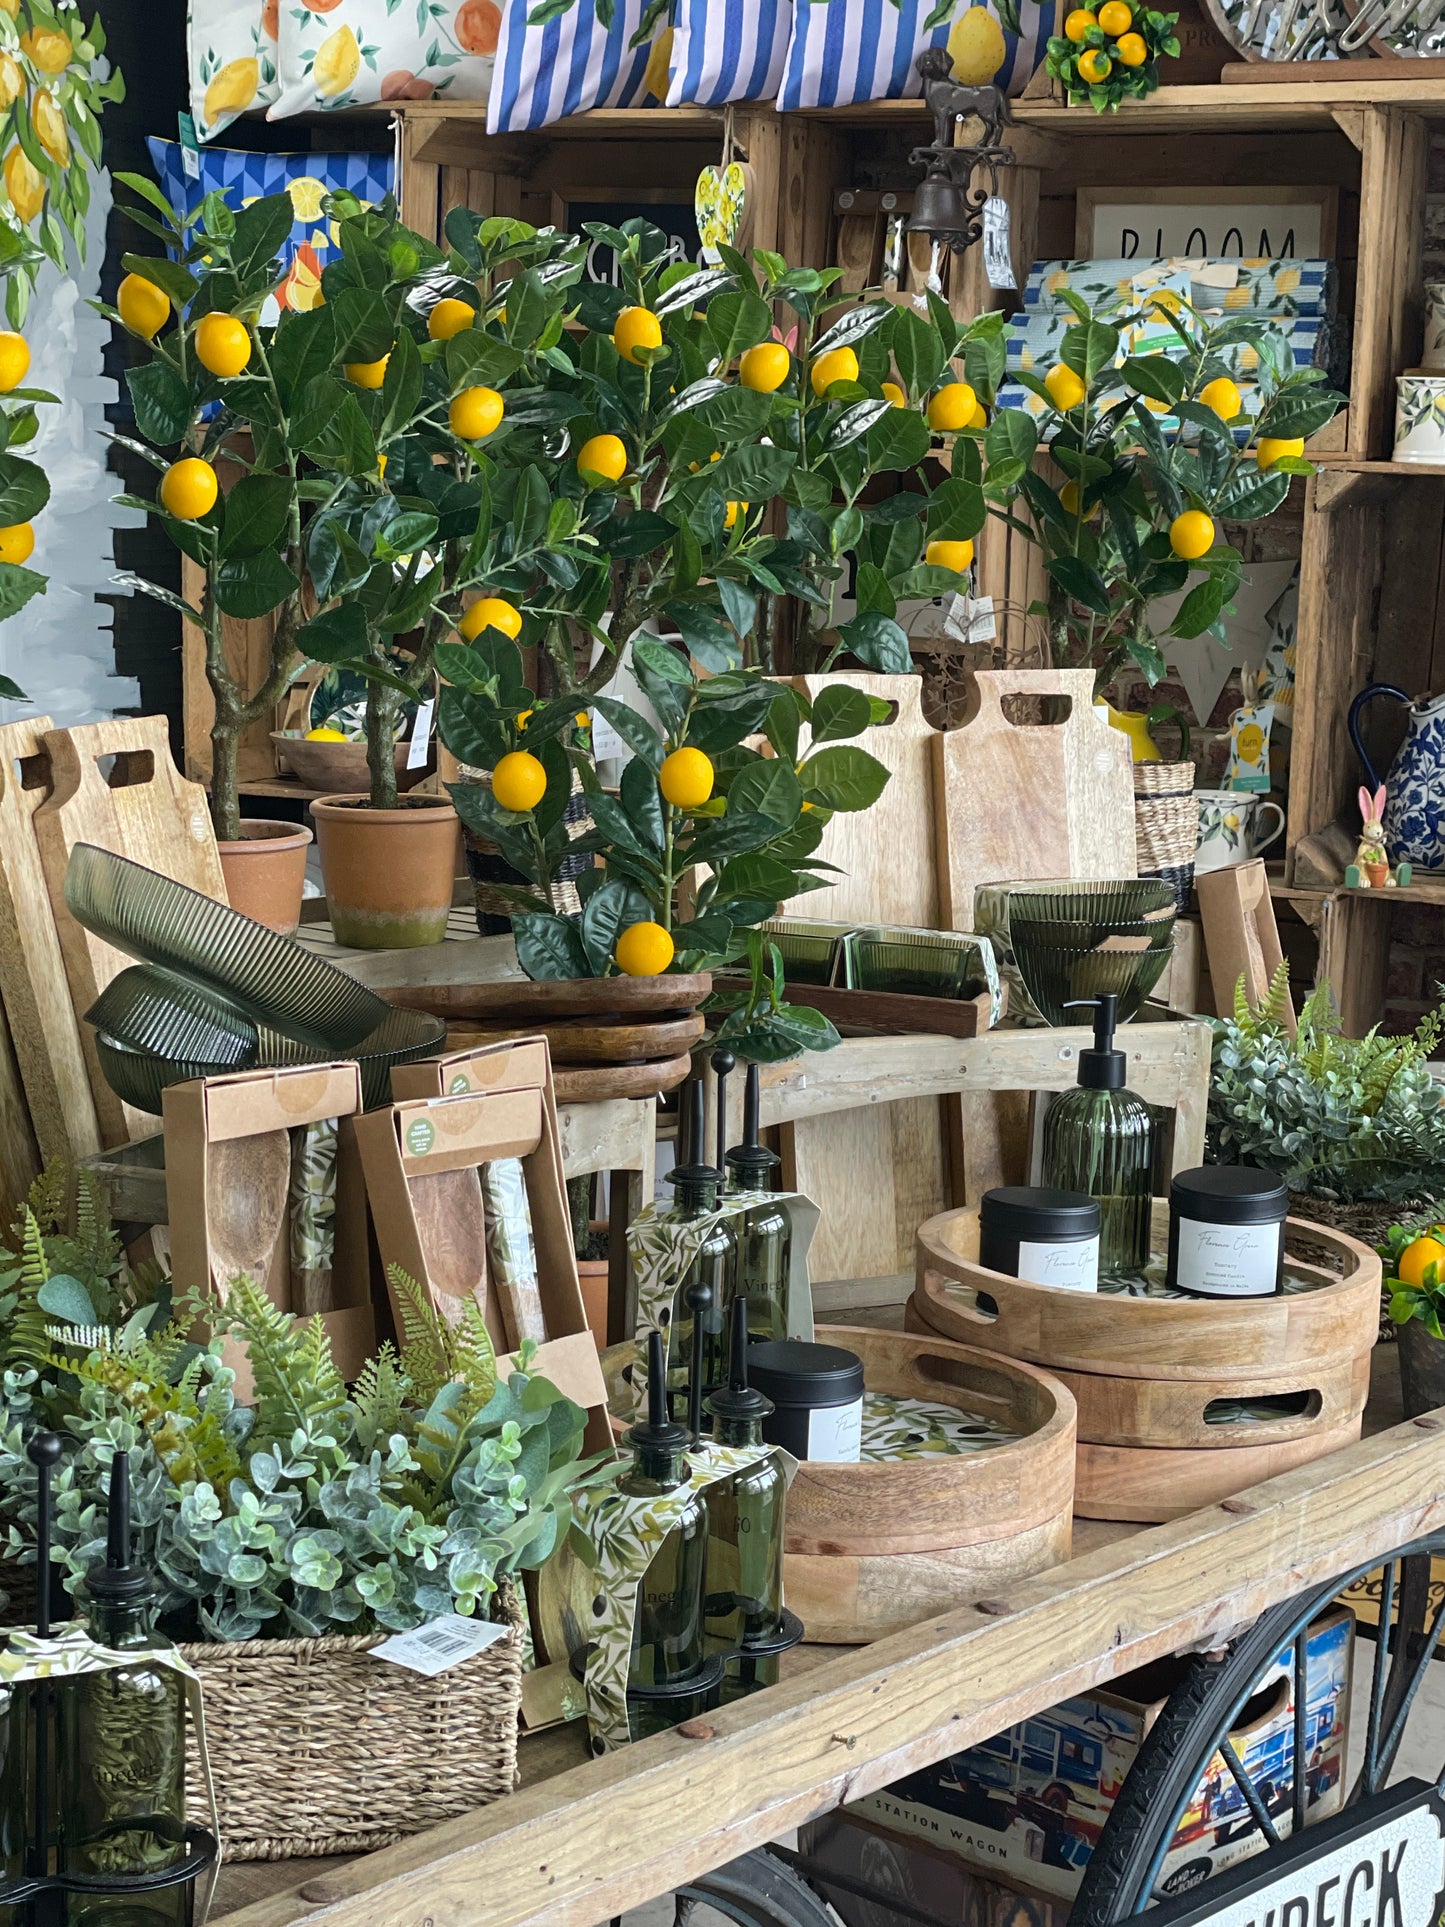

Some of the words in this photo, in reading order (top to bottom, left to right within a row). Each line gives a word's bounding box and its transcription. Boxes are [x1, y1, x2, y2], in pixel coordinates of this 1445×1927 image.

[875, 1800, 939, 1832] STATION
[949, 1828, 1008, 1859] WAGON
[1239, 1836, 1265, 1855] STATIO
